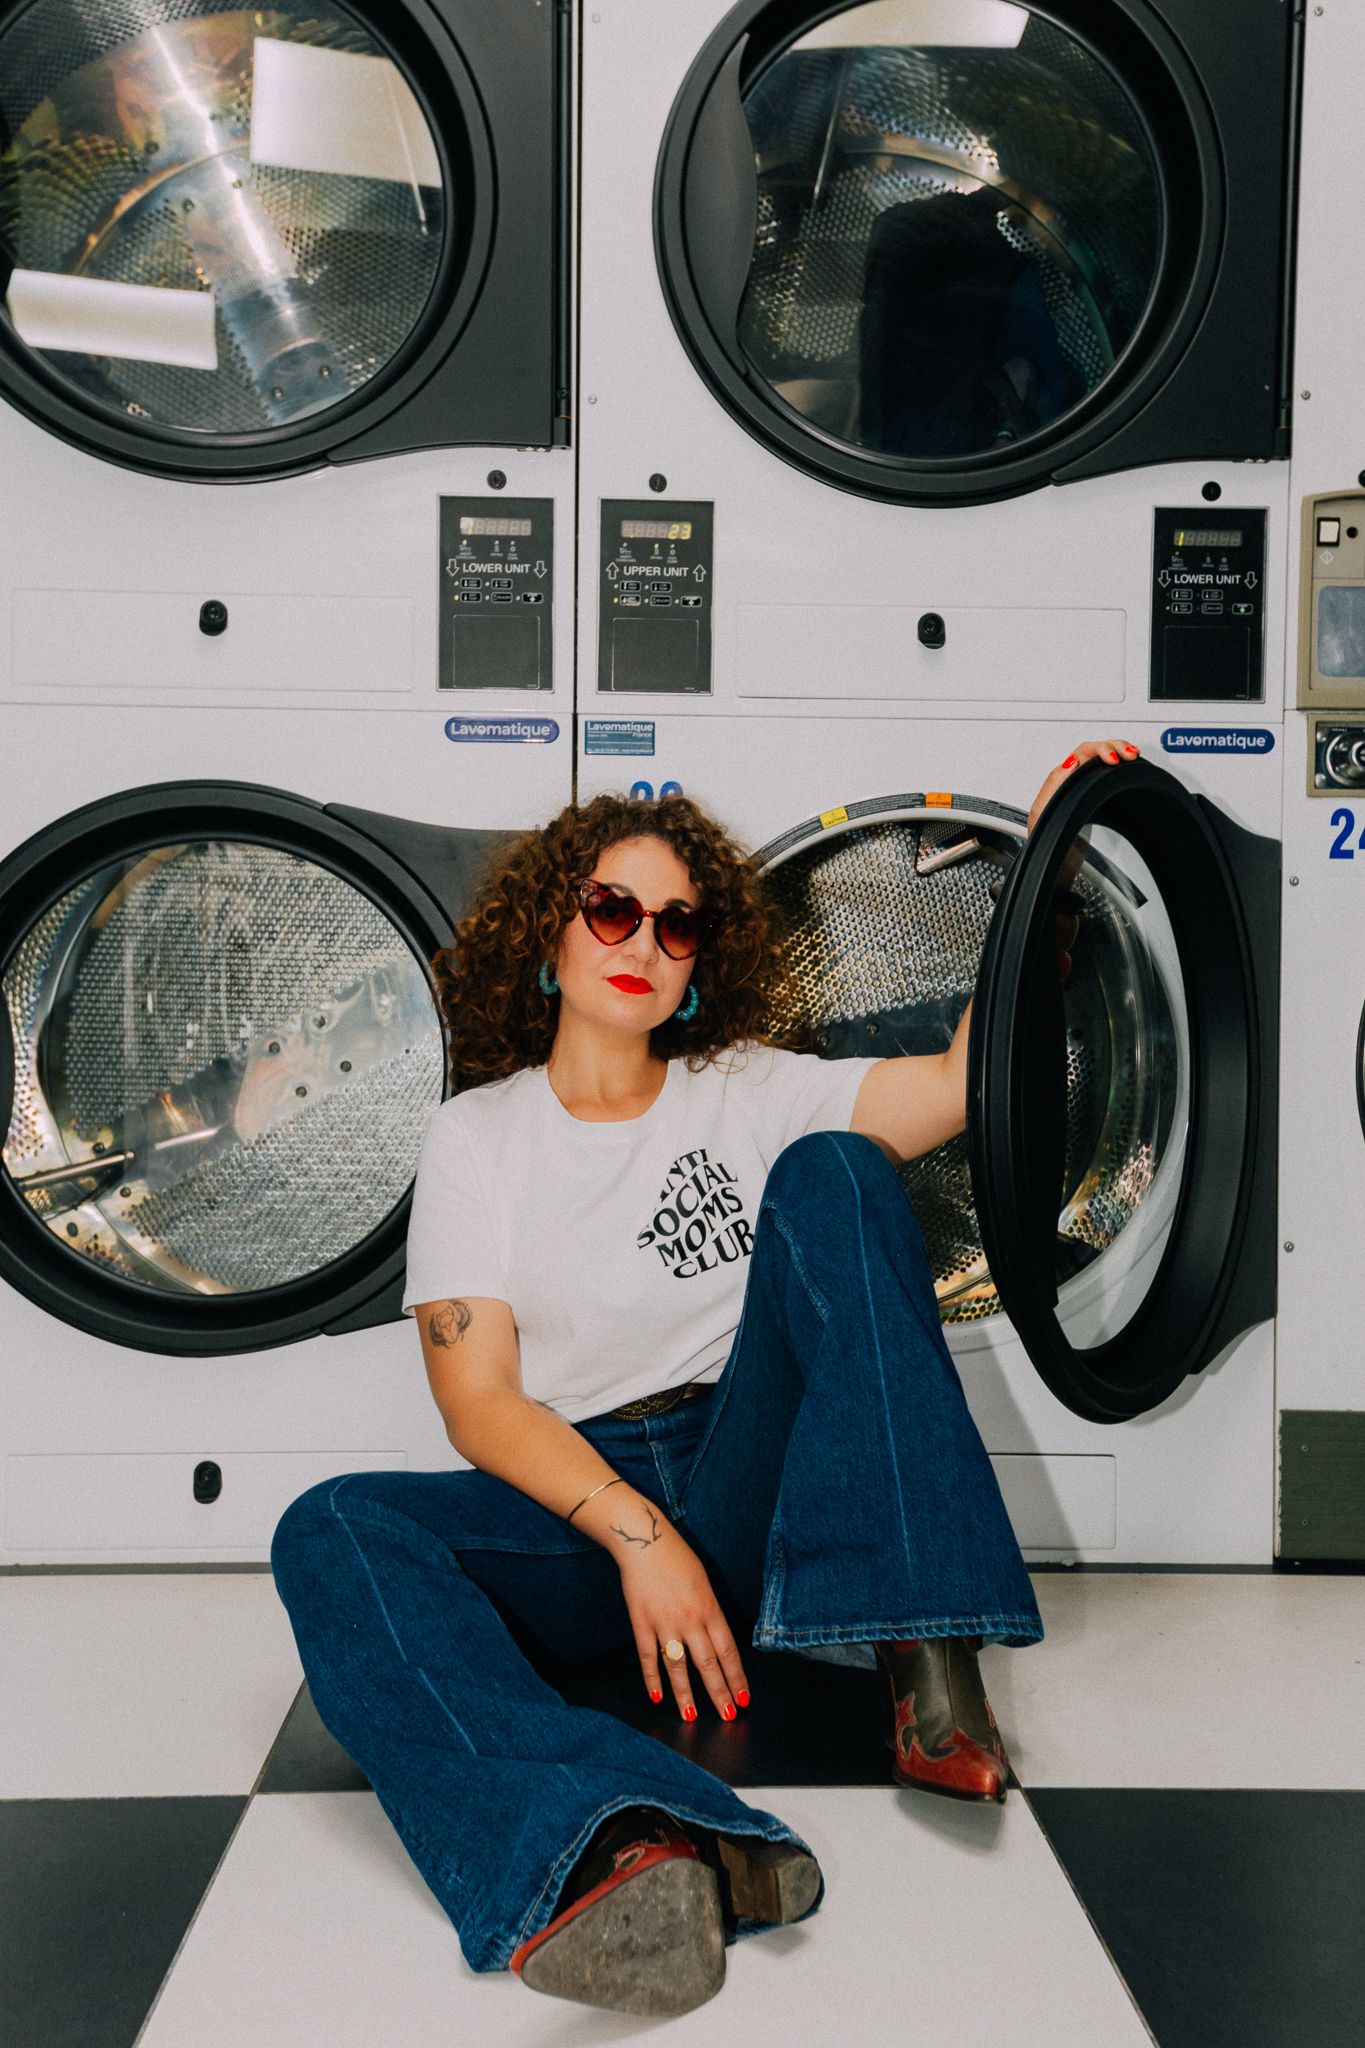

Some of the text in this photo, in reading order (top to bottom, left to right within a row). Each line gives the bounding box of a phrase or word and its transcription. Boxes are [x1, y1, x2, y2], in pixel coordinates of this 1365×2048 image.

[668, 523, 692, 540] 23
[462, 563, 531, 574] LOWER UNIT
[623, 565, 689, 577] UPPER UNIT
[1174, 574, 1241, 584] LOWER UNIT
[450, 722, 551, 738] Lavomatique
[587, 722, 654, 732] Lavomatique
[1167, 733, 1266, 749] Lavomatique
[1329, 807, 1365, 859] 2
[636, 1162, 739, 1250] SOCIAL
[655, 1185, 744, 1268] MOMS
[672, 1218, 755, 1279] CLUB
